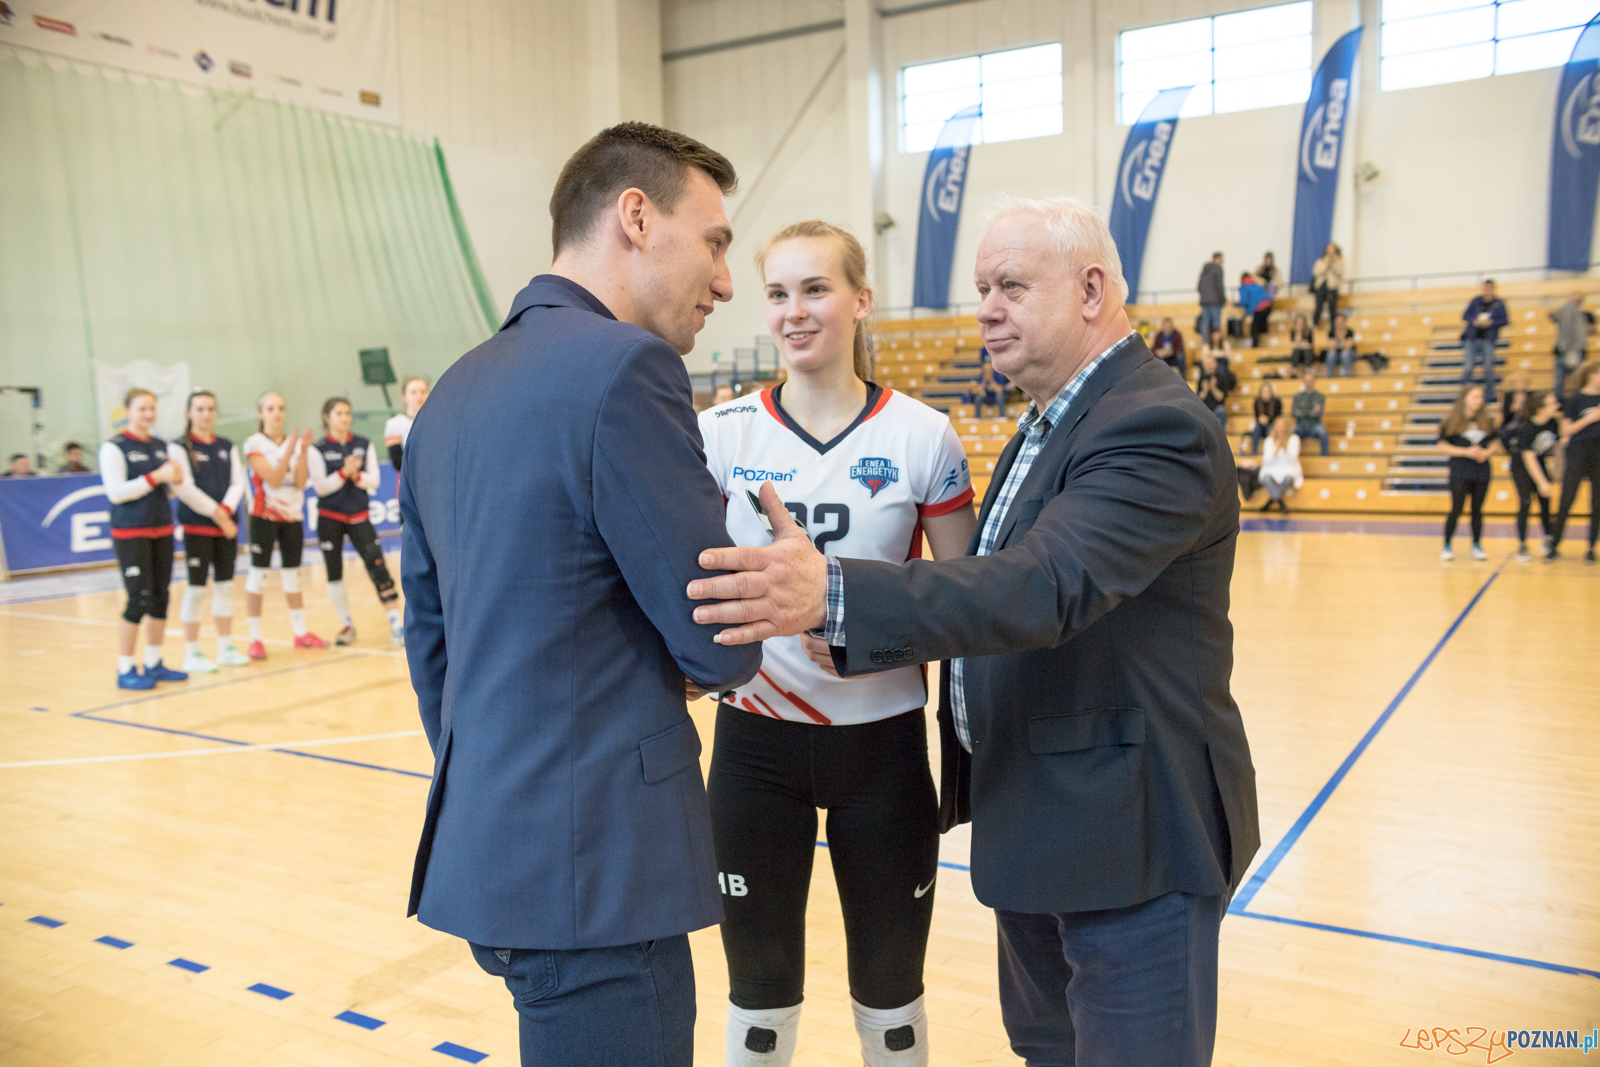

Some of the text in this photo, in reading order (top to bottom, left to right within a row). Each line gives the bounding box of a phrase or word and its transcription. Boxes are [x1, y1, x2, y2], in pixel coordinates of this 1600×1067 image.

[1314, 78, 1348, 170] Enea
[1132, 121, 1172, 202] Enea
[851, 466, 898, 481] ENERGETYK
[865, 459, 885, 468] ENEA
